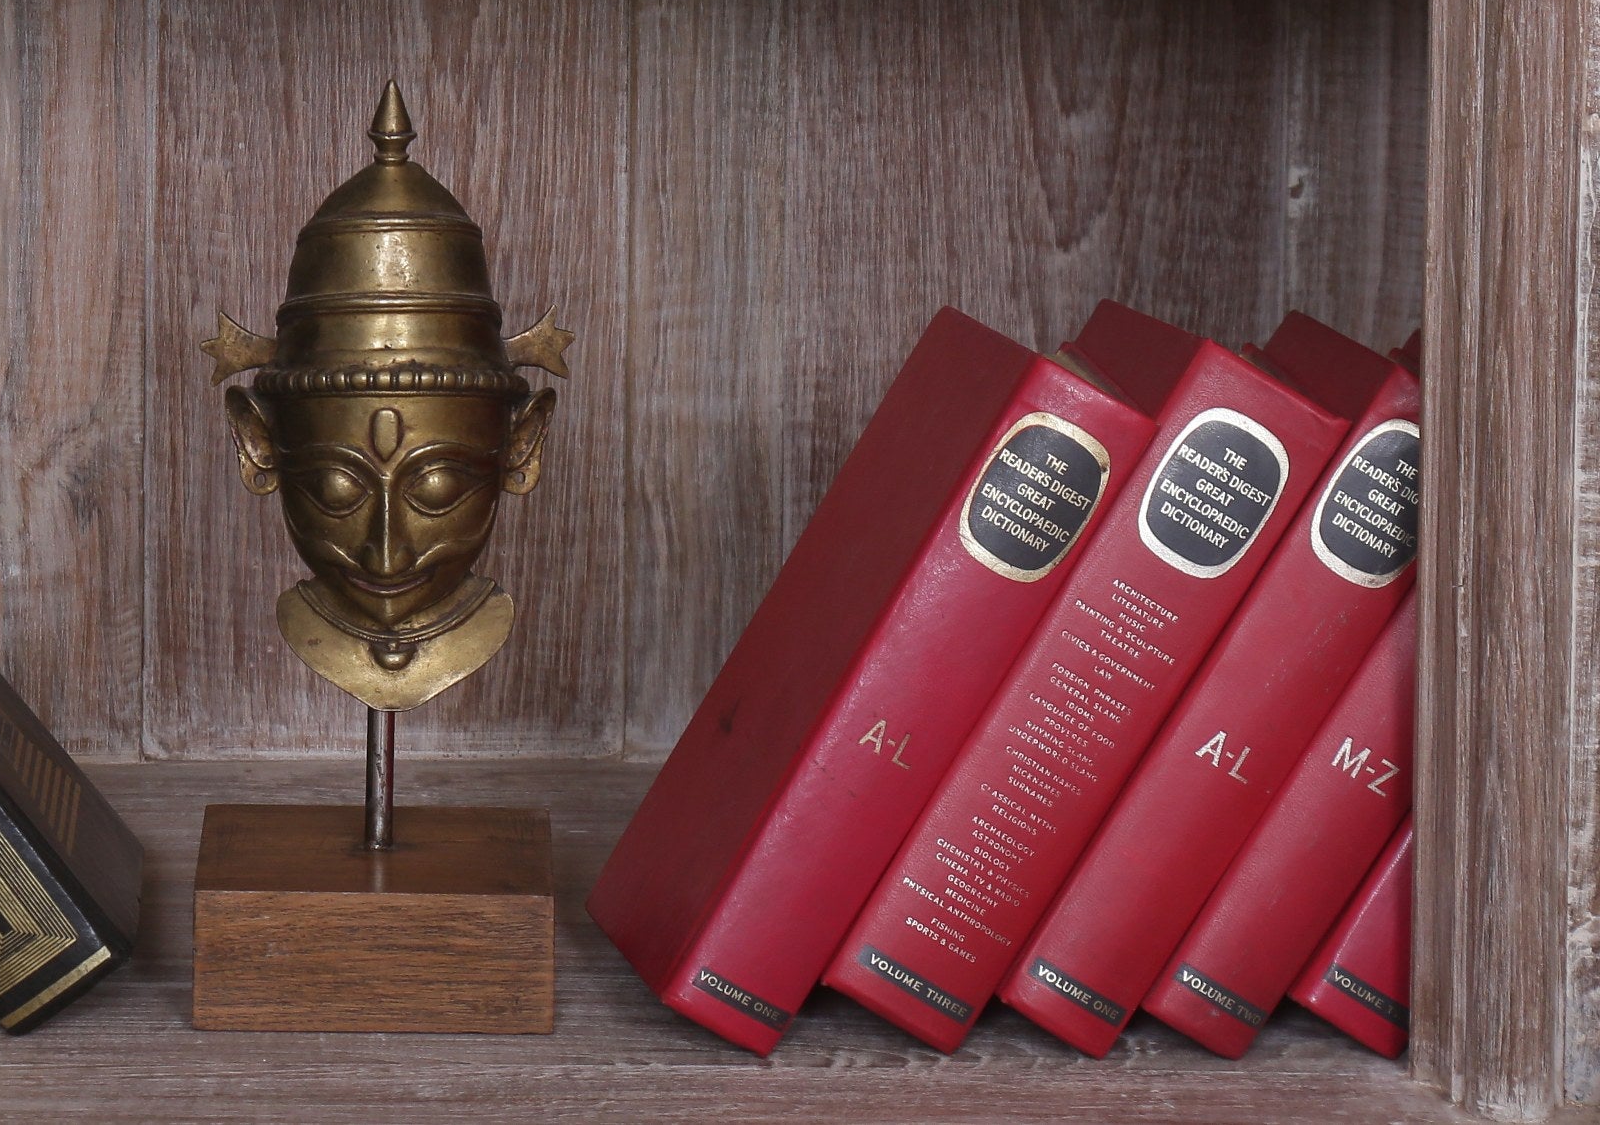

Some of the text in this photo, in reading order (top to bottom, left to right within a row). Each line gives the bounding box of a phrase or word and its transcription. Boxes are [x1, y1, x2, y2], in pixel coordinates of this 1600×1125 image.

[1045, 453, 1069, 476] THE
[1177, 444, 1272, 507] READER'S DIGEST
[1223, 447, 1248, 471] THE
[1351, 455, 1402, 493] READER'S
[1396, 459, 1418, 480] THE
[998, 448, 1091, 511] READER'S DIGEST
[1017, 483, 1056, 511] GREAT
[1195, 478, 1235, 507] GREAT
[980, 483, 1070, 543] ENCYCLOPAEDIC
[1160, 478, 1250, 539] ENCYCLOPAEDIC
[1333, 490, 1417, 547] ENCYCLOPAEDIC
[1368, 489, 1405, 516] GREAT
[981, 505, 1050, 552] DICTIONARY
[1160, 501, 1229, 549] DICTIONARY
[1332, 512, 1398, 559] DICTIONARY
[1112, 579, 1180, 623] ARCHITECTURE
[1112, 593, 1166, 629] LITERATURE
[1075, 600, 1176, 666] PAINTING & SCULPTURE
[1119, 612, 1147, 632] MUSIC
[1062, 630, 1091, 652] CIVICS
[1099, 654, 1156, 691] GOVERNMENT
[1100, 629, 1141, 659] THEATRE
[1052, 662, 1091, 690] FOREIGN
[1050, 676, 1121, 723] GENERAL SLANG
[1065, 700, 1095, 722] IDIOMS
[1025, 720, 1065, 749] RHYMING
[1029, 692, 1115, 749] LANGUAGE OF FOOD
[858, 719, 911, 770] A-L
[1194, 730, 1252, 785] A-L
[1005, 745, 1081, 796] CHRISTIAN NAMES
[1012, 764, 1062, 798] NICKNAMES
[1331, 736, 1400, 798] M-Z
[1008, 776, 1054, 808] SURNAMES
[972, 815, 1035, 857] ARCHAEOLOGY
[991, 804, 1037, 836] RELIGIONS
[936, 838, 986, 871] CHEMISTRY
[972, 829, 1024, 864] ASTRONOMY
[973, 846, 1012, 872] BIOLOGY
[947, 874, 999, 908] GEOGRAPHY
[974, 874, 985, 886] TV
[902, 876, 1012, 948] PHYSICAL ANTHROPOLOGY
[944, 887, 987, 917] MEDICINE
[905, 916, 977, 964] SPORTS & GAMES
[931, 917, 967, 943] FISHING
[700, 970, 780, 1021] VOLUME ONE
[870, 953, 968, 1018] VOLUME THREE
[1038, 964, 1119, 1020] VOLUME ONE
[1182, 970, 1261, 1025] VOLUME TWO
[1334, 970, 1385, 1009] VOLUME
